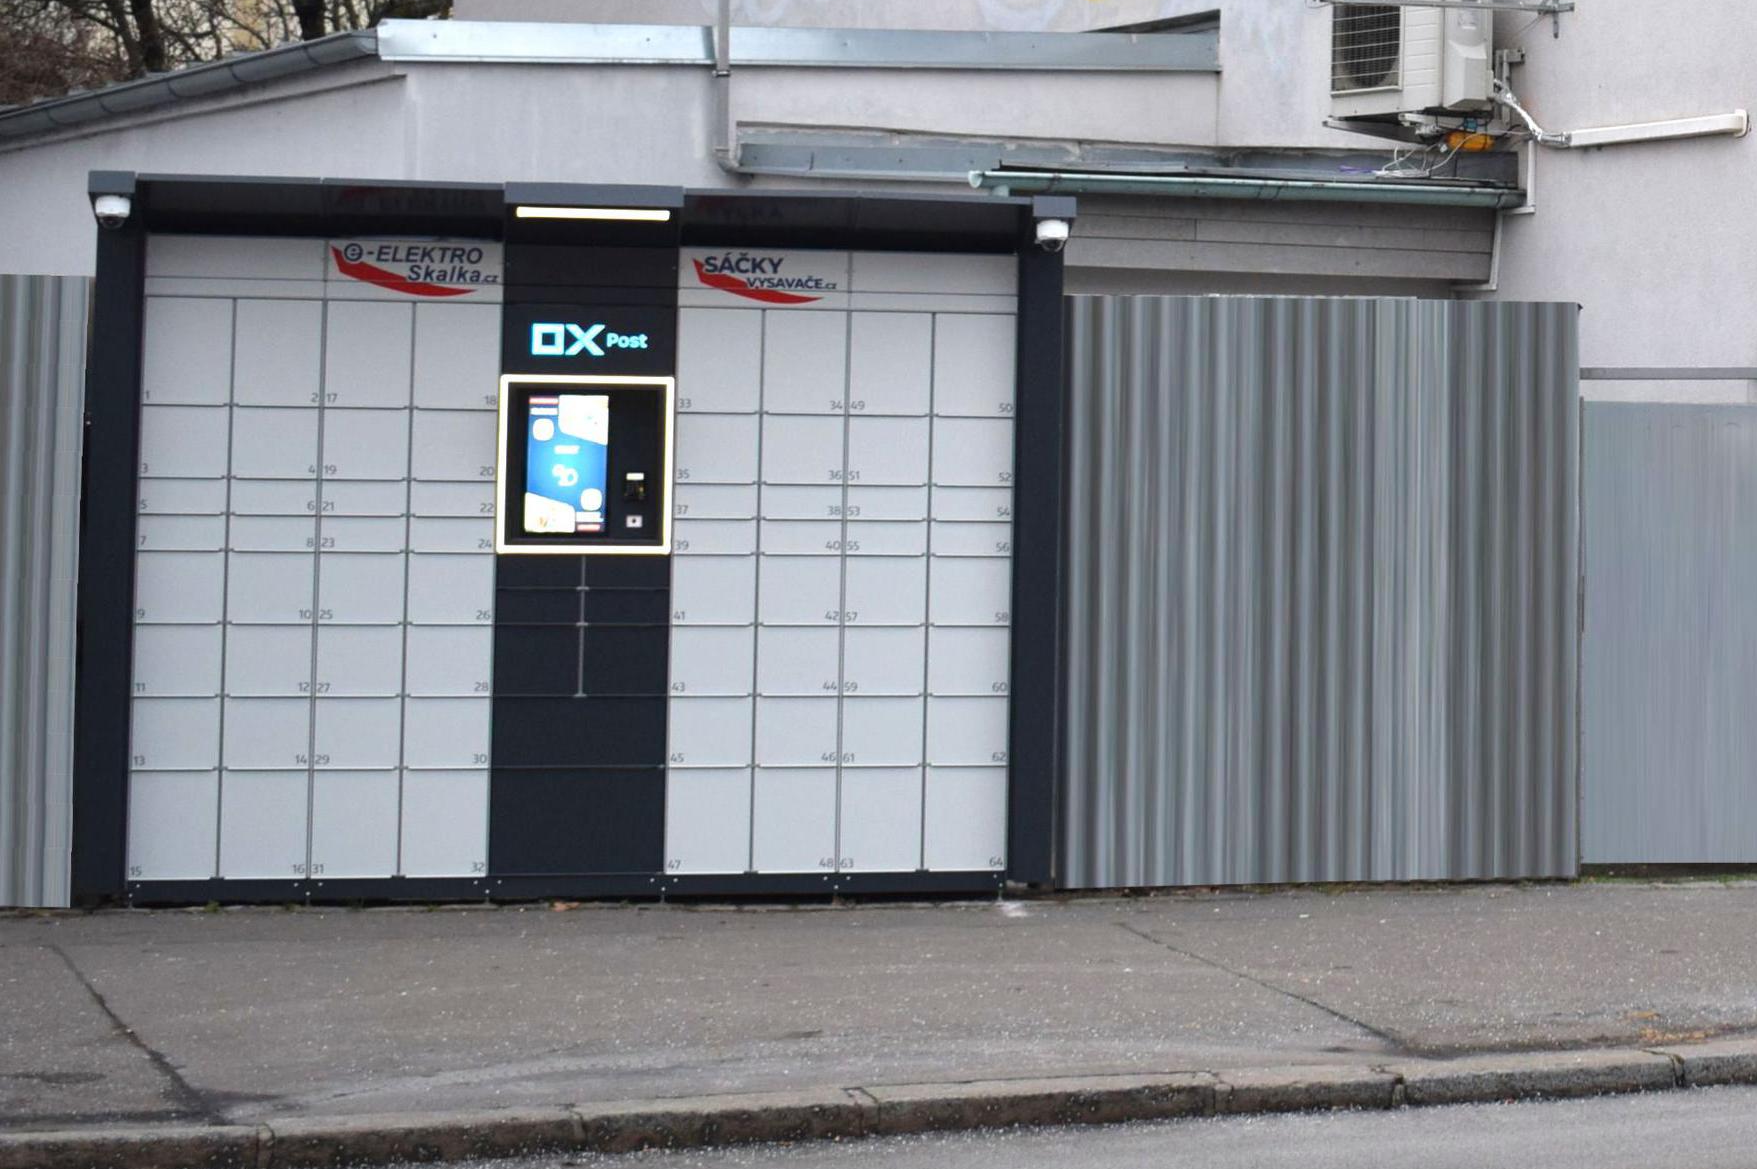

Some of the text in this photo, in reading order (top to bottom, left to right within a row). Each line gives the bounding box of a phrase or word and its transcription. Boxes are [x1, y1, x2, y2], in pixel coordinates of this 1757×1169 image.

[704, 252, 783, 275] SÁČKY
[606, 332, 648, 350] Post
[326, 392, 338, 403] 17
[484, 395, 497, 406] 18
[678, 398, 692, 409] 33
[830, 400, 844, 410] 34
[850, 400, 866, 411] 49
[998, 402, 1014, 413] 50
[323, 465, 337, 475] 19
[480, 466, 495, 476] 20
[676, 469, 690, 479] 35
[828, 470, 842, 480] 36
[848, 470, 860, 480] 51
[998, 472, 1012, 482] 52
[322, 501, 335, 512] 21
[480, 502, 495, 512] 22
[675, 505, 688, 515] 37
[827, 506, 841, 516] 38
[847, 506, 861, 516] 53
[996, 506, 1011, 516] 54
[320, 537, 335, 548] 23
[477, 538, 492, 549] 24
[675, 540, 690, 551] 39
[825, 540, 841, 551] 40
[846, 540, 860, 551] 55
[995, 542, 1010, 553] 56
[299, 609, 312, 620] 10
[319, 609, 333, 620] 25
[476, 610, 491, 620] 26
[673, 611, 686, 621] 41
[824, 611, 840, 621] 42
[844, 611, 858, 622] 57
[995, 612, 1009, 622] 58
[135, 682, 146, 692] 11
[298, 682, 310, 692] 12
[316, 683, 330, 693] 27
[474, 682, 489, 692] 28
[671, 682, 686, 692] 43
[822, 682, 838, 691] 44
[843, 682, 858, 692] 59
[992, 682, 1007, 692] 60
[133, 756, 146, 766] 13
[295, 755, 308, 765] 14
[314, 754, 330, 765] 29
[472, 754, 488, 764] 30
[670, 752, 685, 763] 45
[821, 751, 837, 762] 46
[843, 752, 855, 762] 61
[991, 752, 1007, 762] 62
[668, 859, 681, 870] 47
[818, 857, 834, 868] 48
[840, 858, 854, 868] 63
[989, 856, 1004, 867] 64
[130, 865, 142, 876] 15
[292, 864, 306, 874] 16
[311, 863, 324, 874] 31
[471, 862, 486, 873] 32
